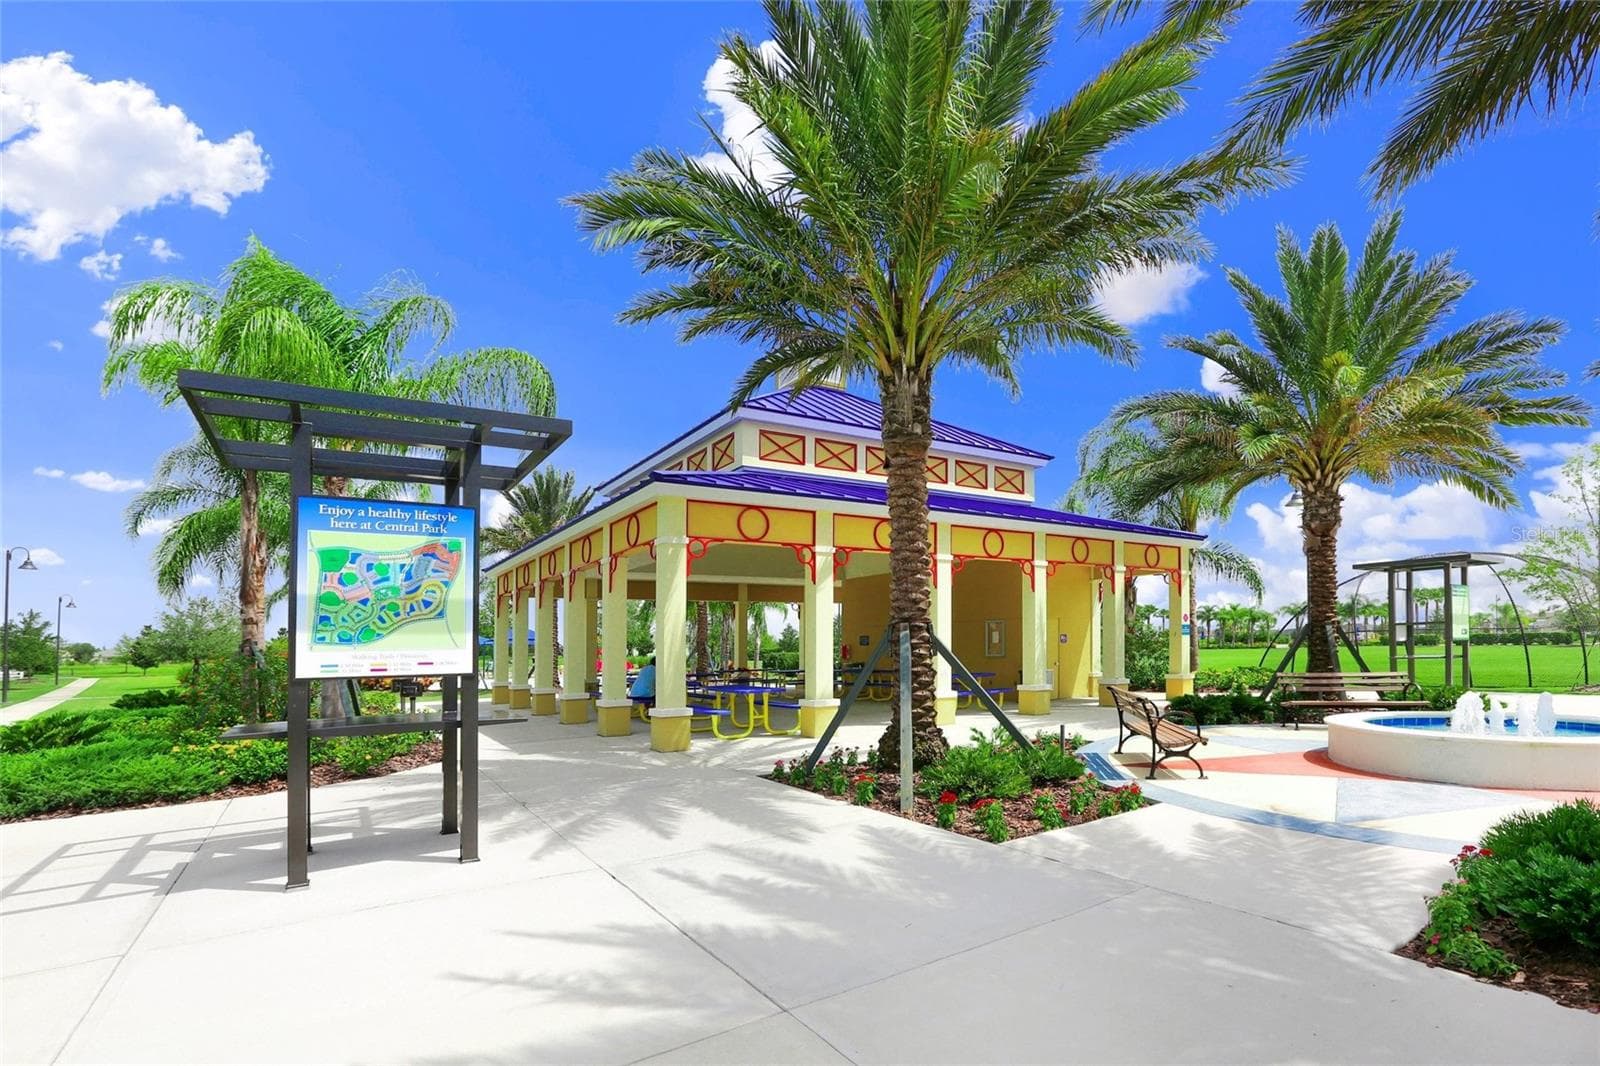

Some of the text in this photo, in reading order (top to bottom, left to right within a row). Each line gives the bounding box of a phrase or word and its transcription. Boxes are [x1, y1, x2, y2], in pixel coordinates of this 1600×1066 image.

[319, 504, 458, 524] Enjoy a healthy lifestyle
[330, 517, 448, 535] here at Central Park
